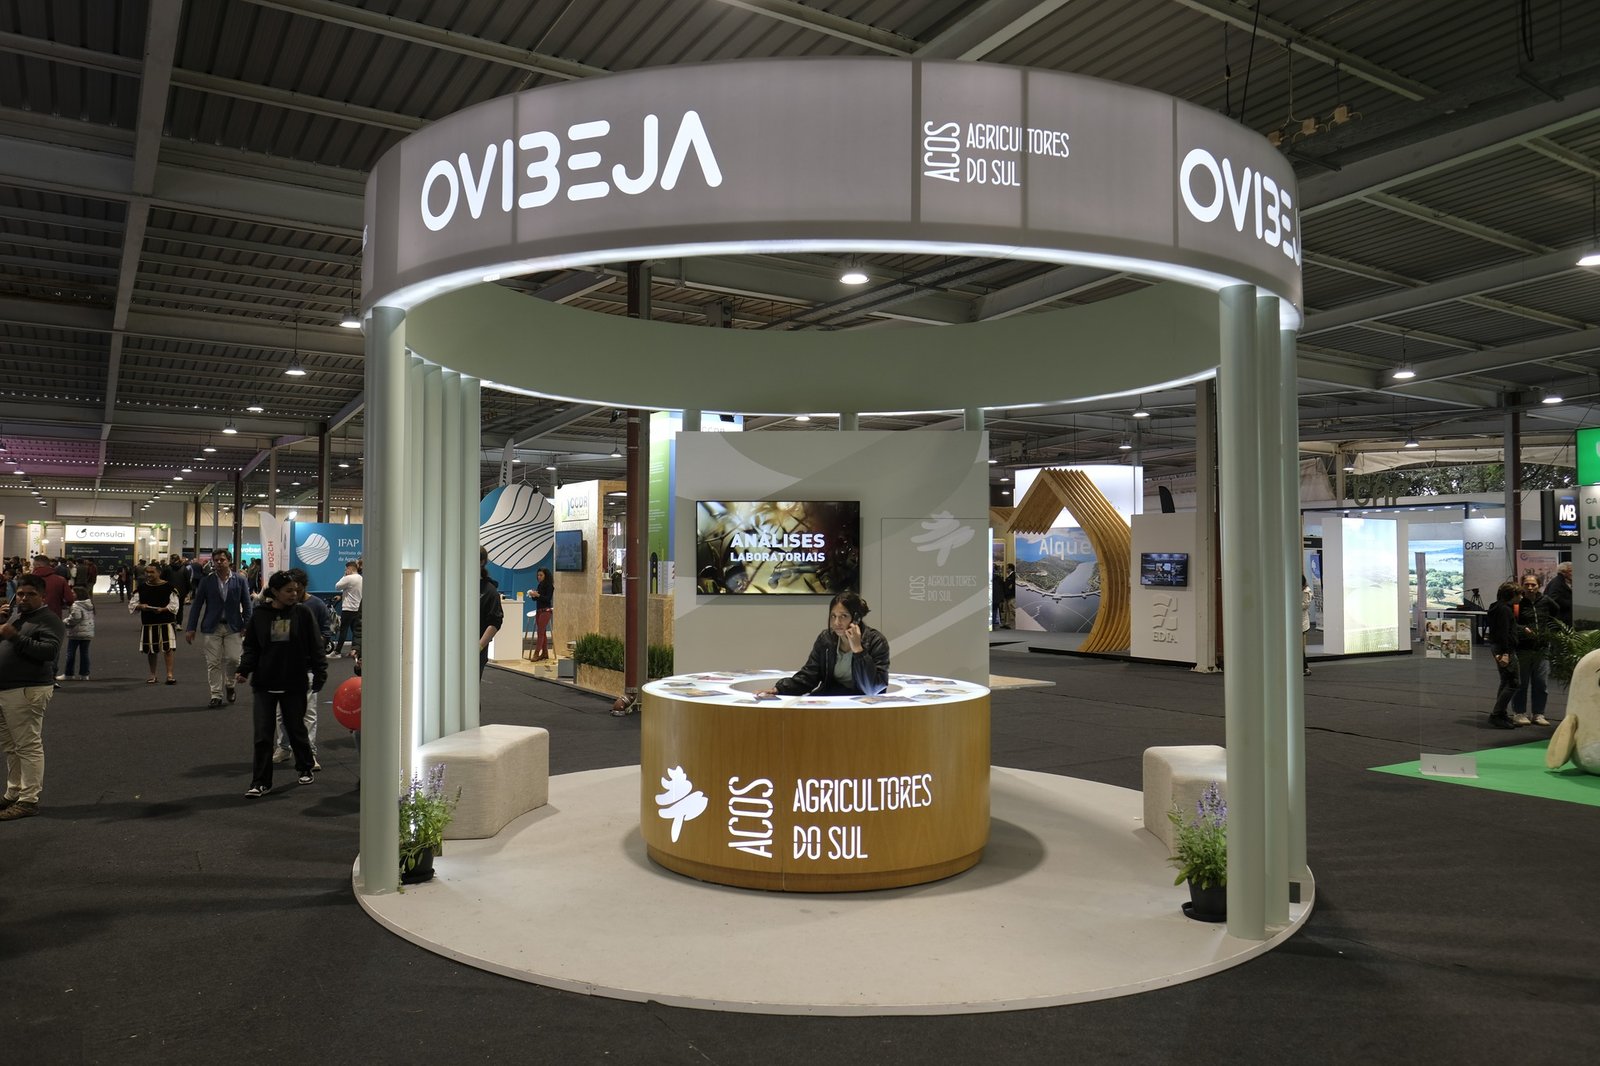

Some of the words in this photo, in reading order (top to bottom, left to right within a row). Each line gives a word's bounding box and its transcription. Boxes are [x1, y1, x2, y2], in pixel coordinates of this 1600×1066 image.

[924, 120, 960, 182] ACOS
[966, 122, 1070, 158] AGRICULTORES
[421, 110, 723, 231] OVIBEJA
[966, 158, 987, 184] DO
[991, 161, 1021, 187] SUL
[1559, 504, 1576, 521] MB
[89, 530, 126, 538] consulai
[338, 538, 360, 547] IFAP
[1588, 537, 1600, 549] p
[730, 552, 826, 562] LABORATORIAIS
[909, 576, 926, 600] ACOS
[927, 590, 939, 601] DO
[939, 590, 952, 601] SUL
[1153, 632, 1178, 643] EDIA
[793, 773, 932, 813] AGRICULTORES
[728, 776, 774, 858] ACOS
[793, 825, 821, 860] DO
[828, 825, 868, 860] SUL
